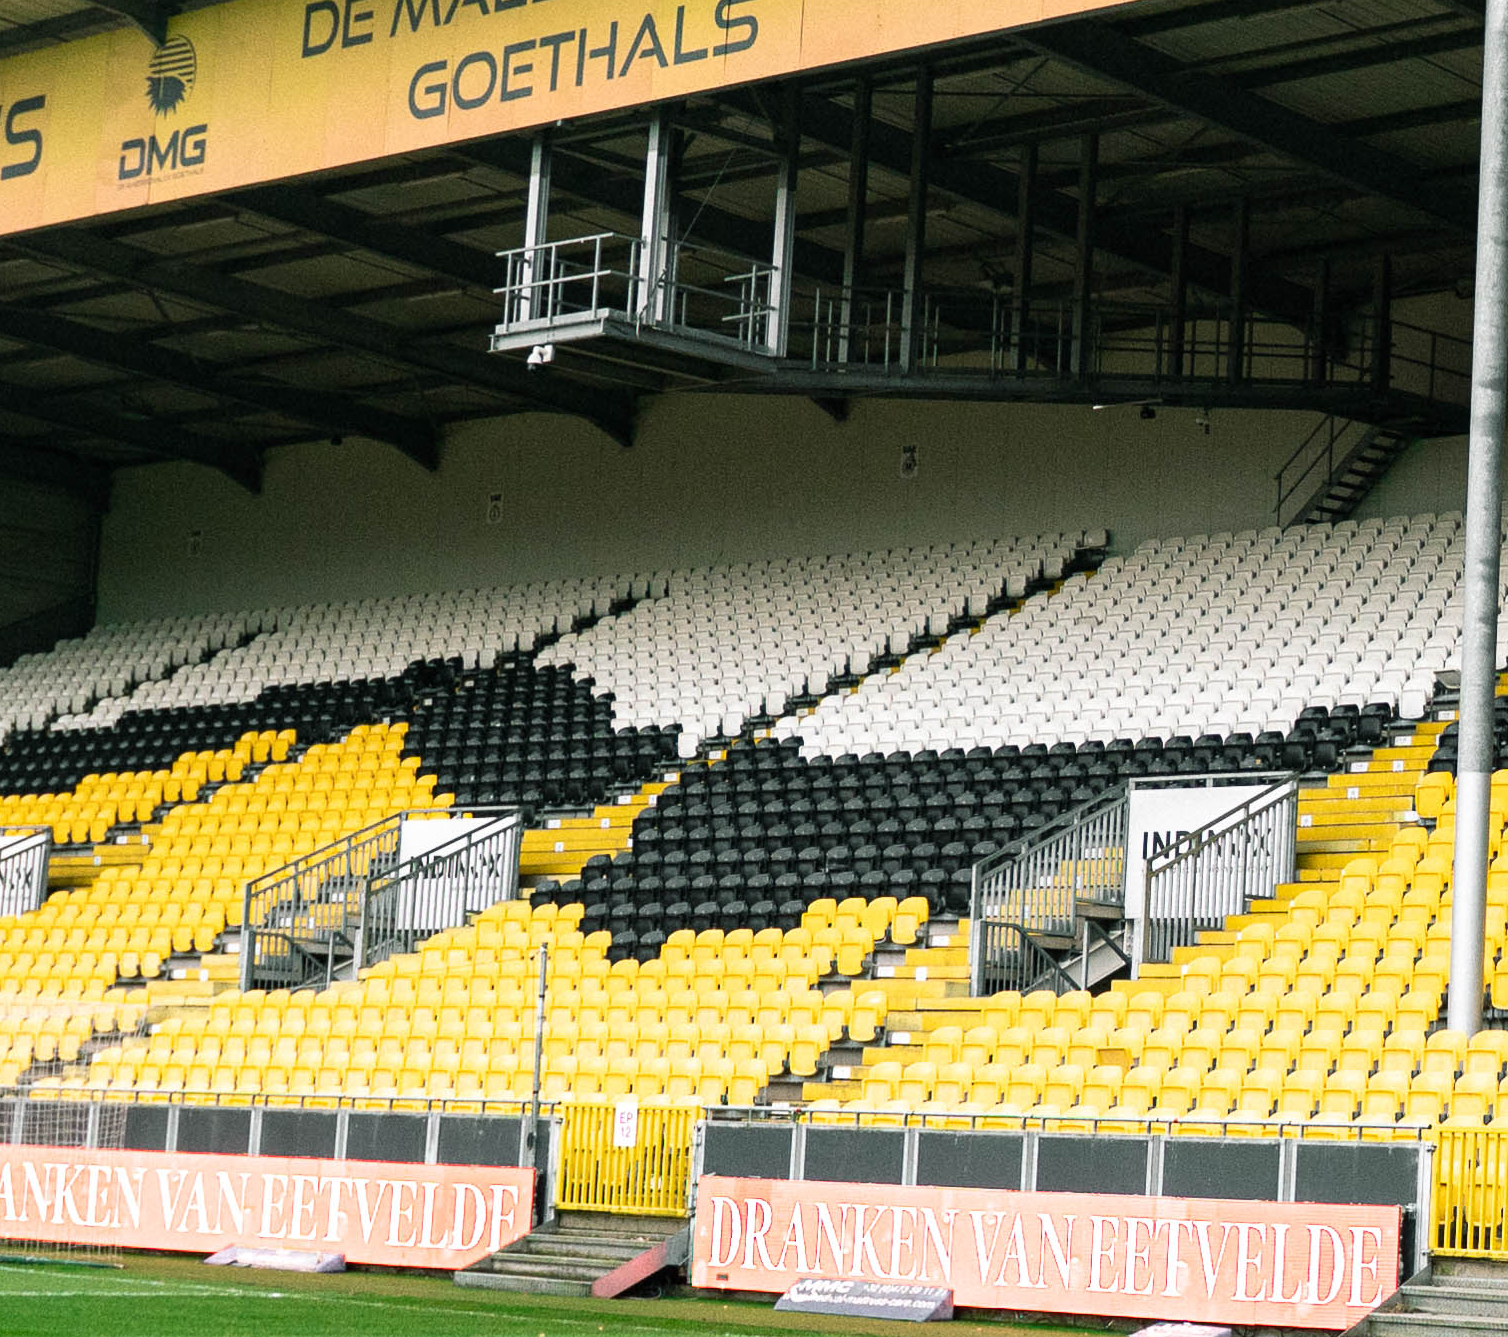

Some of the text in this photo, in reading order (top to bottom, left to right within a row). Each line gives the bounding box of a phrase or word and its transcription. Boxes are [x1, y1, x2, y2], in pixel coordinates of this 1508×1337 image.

[118, 123, 208, 180] DMG
[620, 1111, 633, 1124] EP
[621, 1126, 631, 1138] 12
[156, 1167, 255, 1235] VAN
[258, 1174, 520, 1252] EETVELDE
[708, 1196, 1384, 1308] DRANKEN VAN EETVELDE
